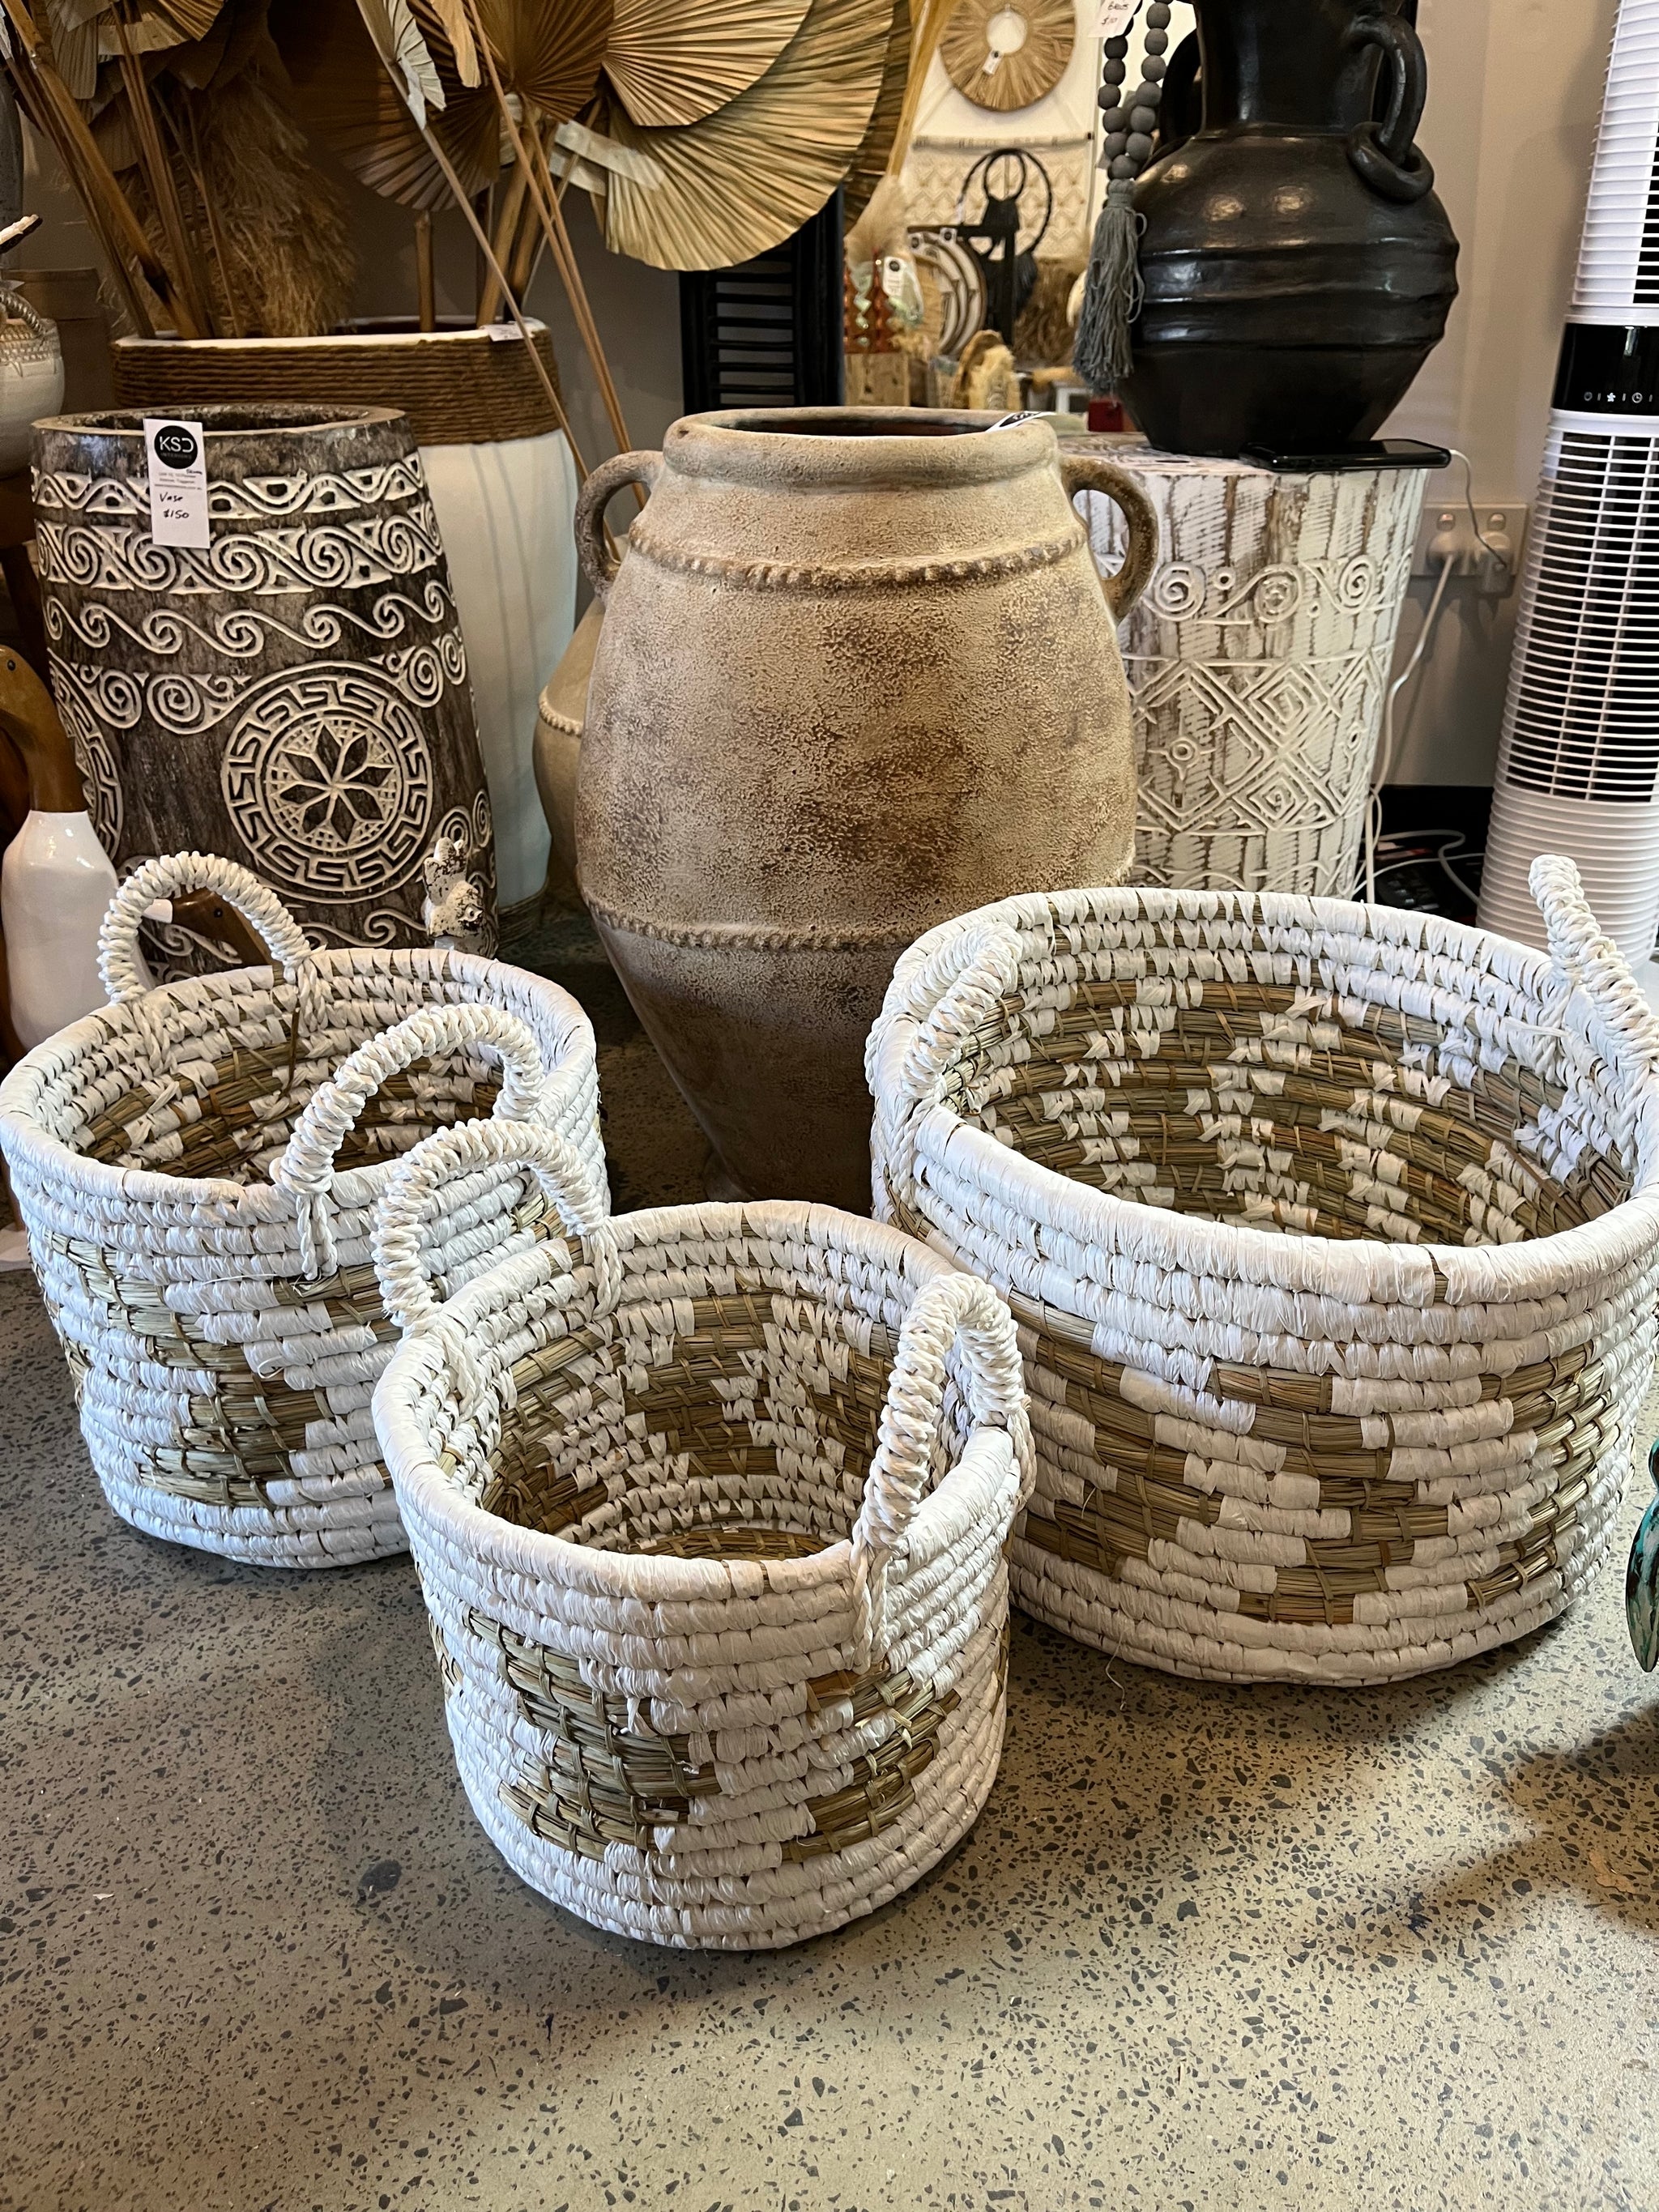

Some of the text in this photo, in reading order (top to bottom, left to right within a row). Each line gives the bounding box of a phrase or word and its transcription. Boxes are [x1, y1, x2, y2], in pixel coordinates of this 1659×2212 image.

[160, 436, 194, 453] KSD
[160, 492, 183, 502] Vase
[163, 509, 190, 519] $150
